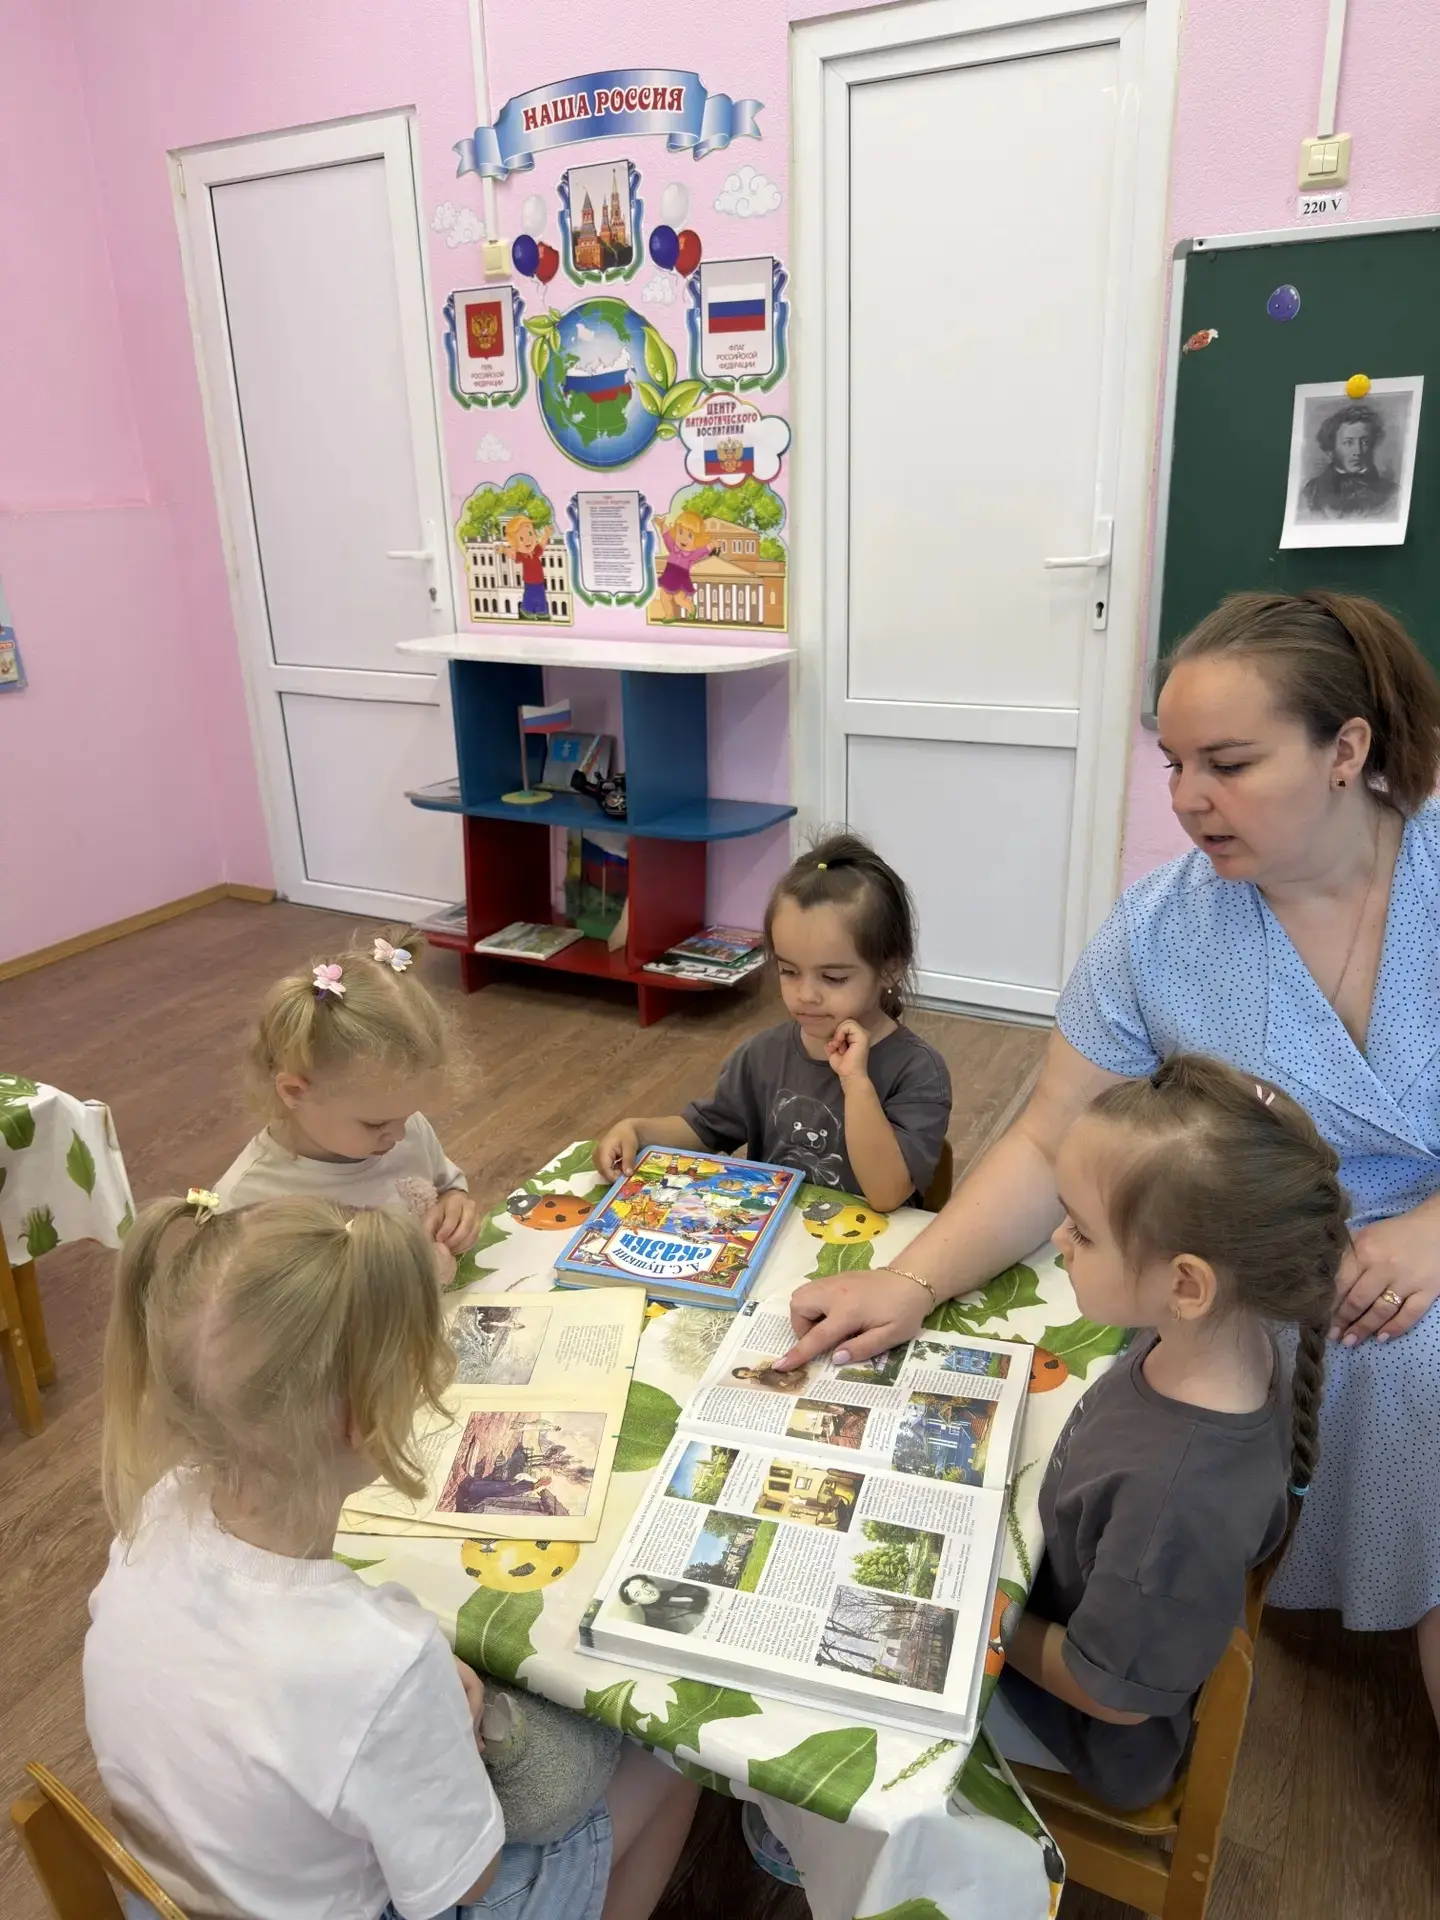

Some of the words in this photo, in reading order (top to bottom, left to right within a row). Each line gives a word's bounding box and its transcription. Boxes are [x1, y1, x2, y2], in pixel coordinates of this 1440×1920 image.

[521, 93, 591, 132] НАША
[595, 86, 685, 115] РОССИЯ
[1303, 200, 1327, 215] 220
[1331, 198, 1342, 211] V
[716, 351, 758, 360] РОССИЙСКОЙ
[718, 361, 756, 370] ФЕДЕРАЦИИ
[706, 401, 737, 415] ЦЕНТР
[685, 413, 758, 428] ПАТРИОТИЧЕСКОГО
[696, 424, 744, 437] ВОСПИТАНИЯ
[618, 1233, 713, 1262] сказки
[611, 1247, 667, 1274] Пушкин
